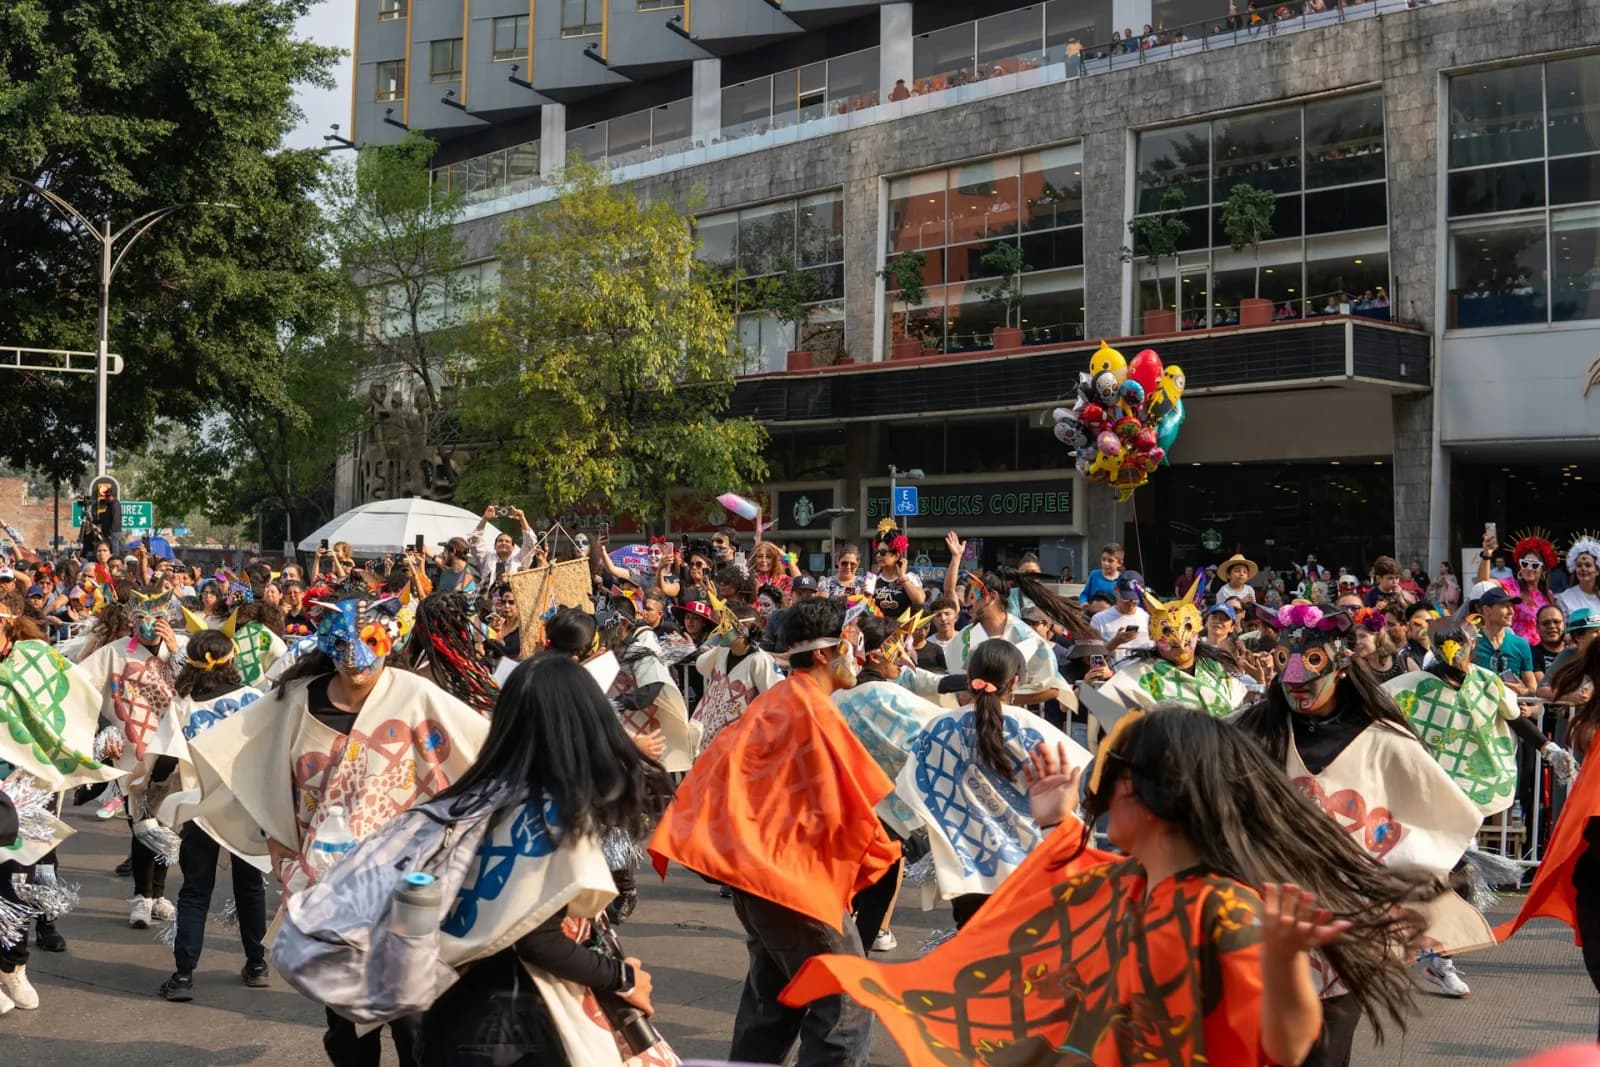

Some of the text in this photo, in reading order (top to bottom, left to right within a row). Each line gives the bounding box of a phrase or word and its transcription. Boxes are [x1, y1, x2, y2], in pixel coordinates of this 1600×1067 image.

[903, 490, 908, 500] E
[867, 492, 1070, 516] STBUCKS COFFEE
